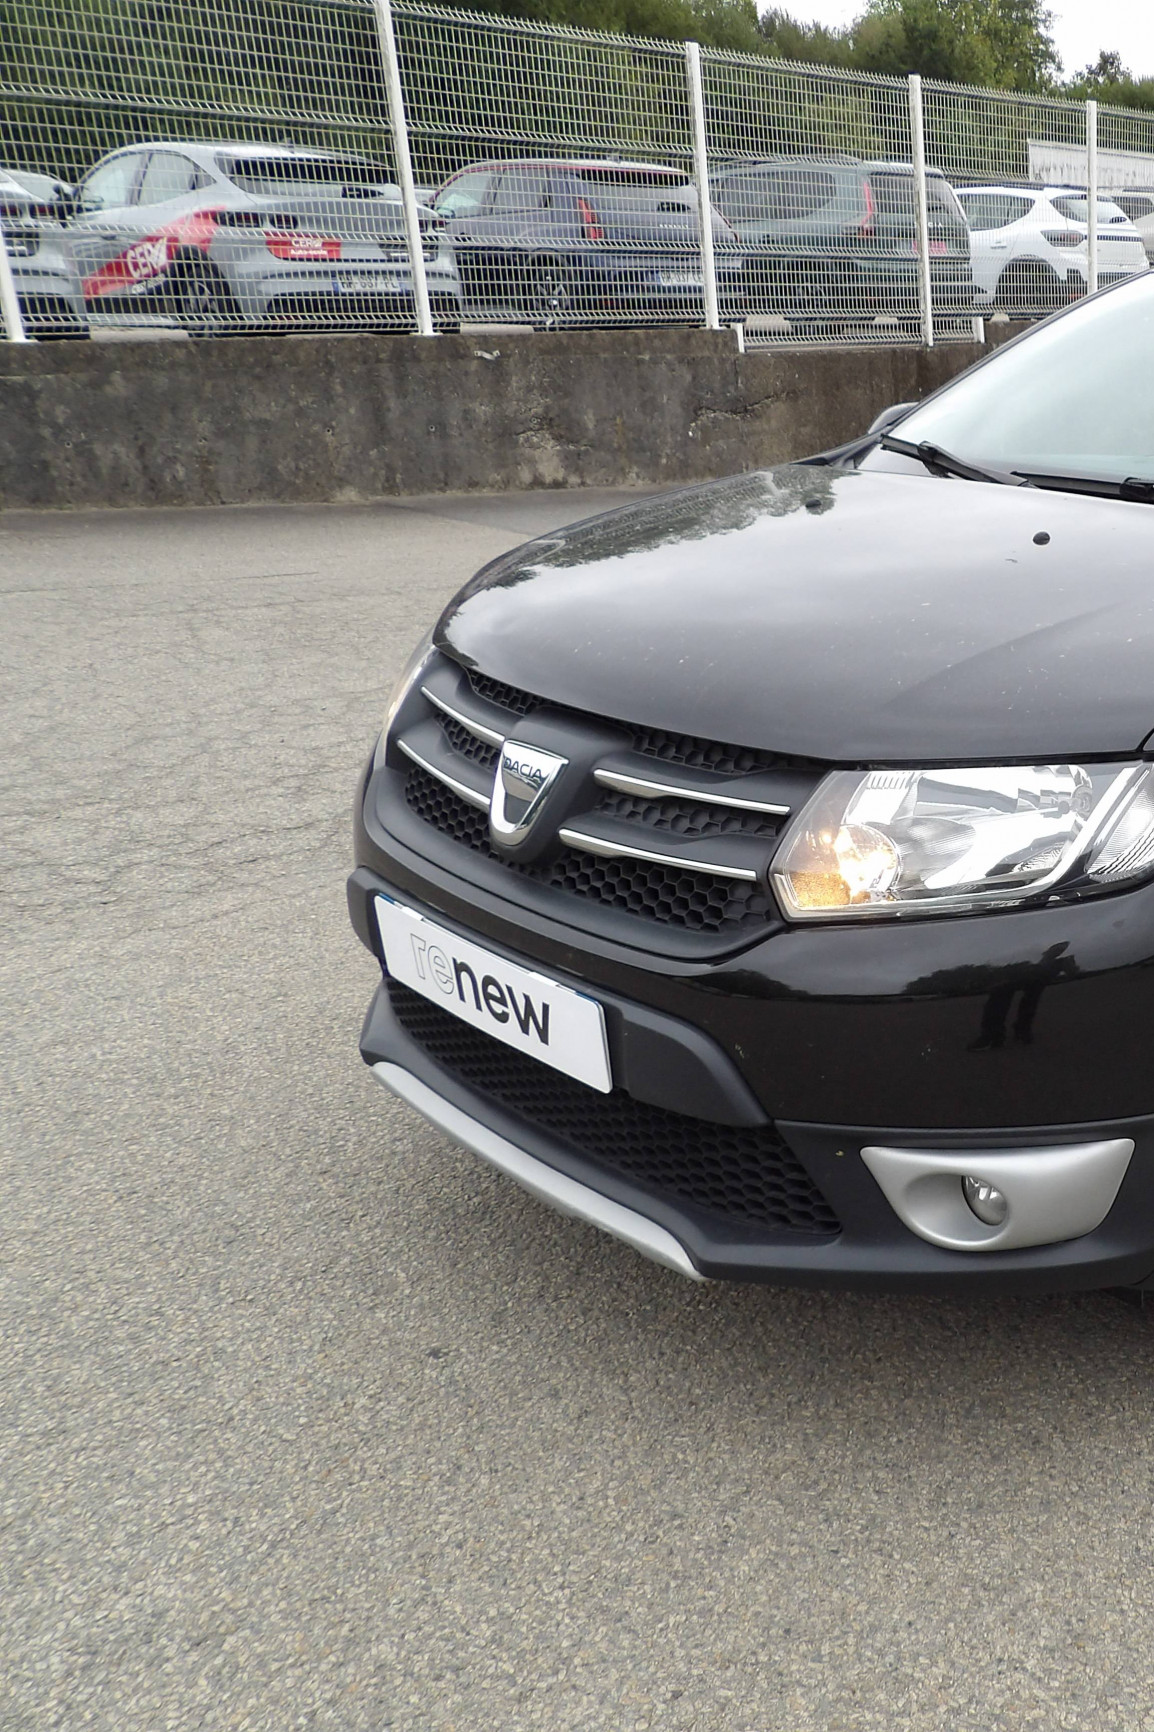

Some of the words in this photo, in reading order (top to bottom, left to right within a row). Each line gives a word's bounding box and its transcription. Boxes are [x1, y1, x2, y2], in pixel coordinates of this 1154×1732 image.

[291, 238, 313, 248] CER
[127, 241, 160, 279] CER
[503, 756, 543, 779] DACIA
[410, 932, 551, 1047] renew
